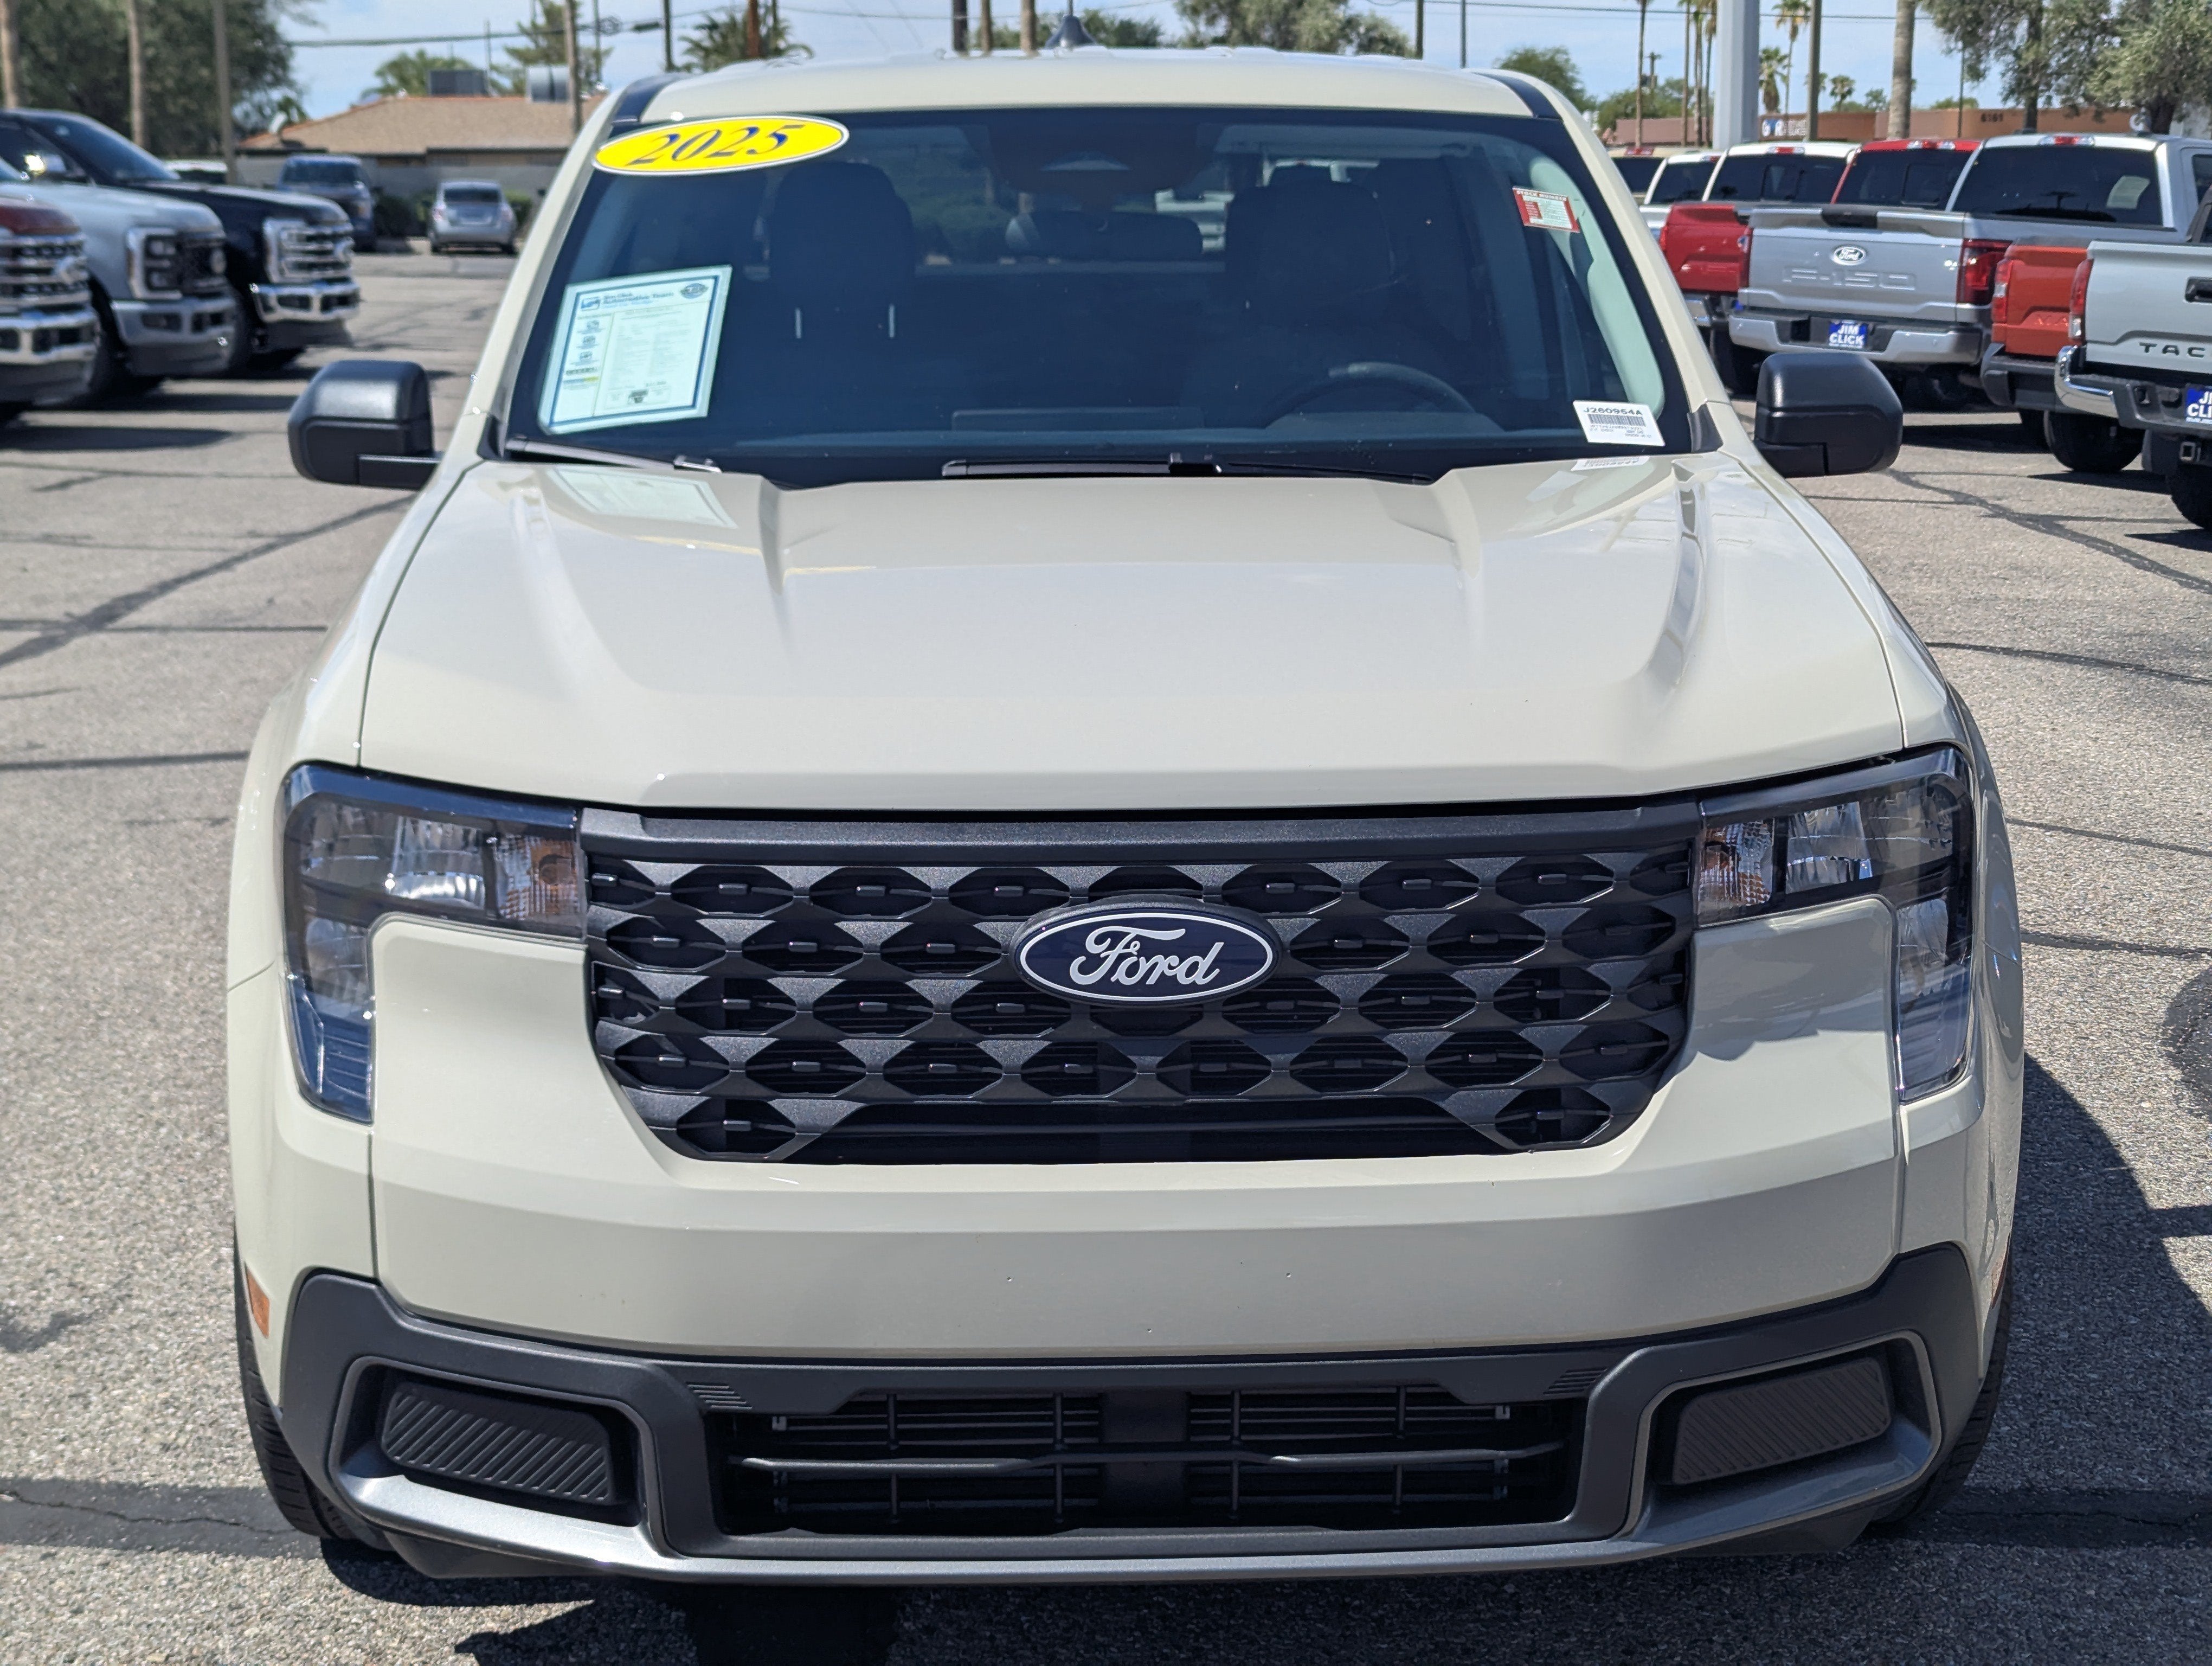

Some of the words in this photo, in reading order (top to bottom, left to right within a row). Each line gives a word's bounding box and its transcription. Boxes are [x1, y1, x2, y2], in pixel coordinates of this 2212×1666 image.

[625, 124, 807, 166] 2025
[1838, 248, 1861, 261] Ford
[1782, 268, 1916, 291] F-150
[1829, 332, 1864, 345] CLICK
[1837, 324, 1860, 335] JIM
[1069, 926, 1224, 985] Ford
